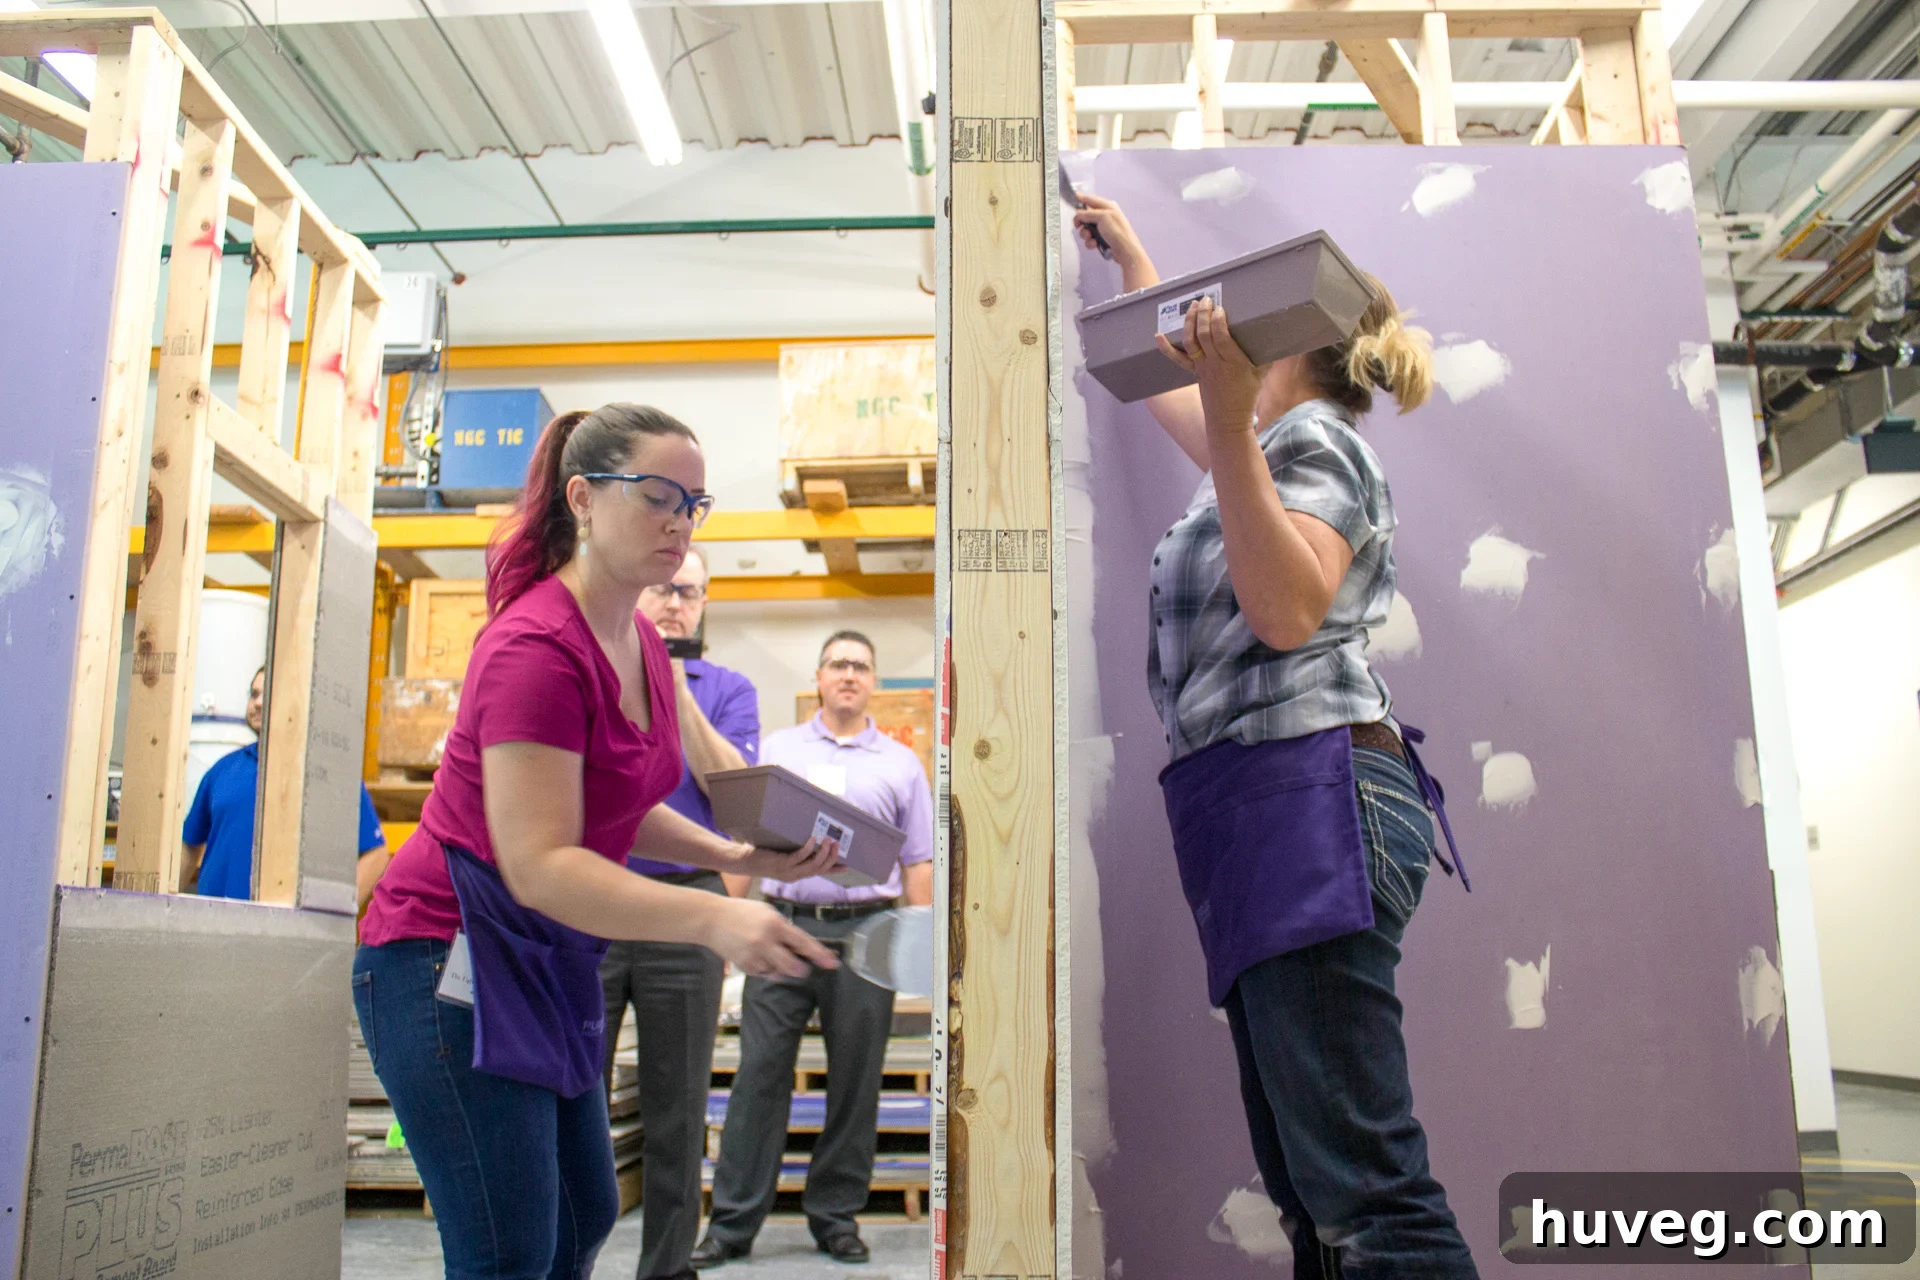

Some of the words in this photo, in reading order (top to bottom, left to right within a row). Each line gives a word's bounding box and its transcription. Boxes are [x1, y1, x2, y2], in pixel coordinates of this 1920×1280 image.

[454, 429, 486, 446] NGC
[497, 427, 524, 446] TIC
[58, 1176, 184, 1280] PLUS
[193, 1219, 255, 1254] Installation
